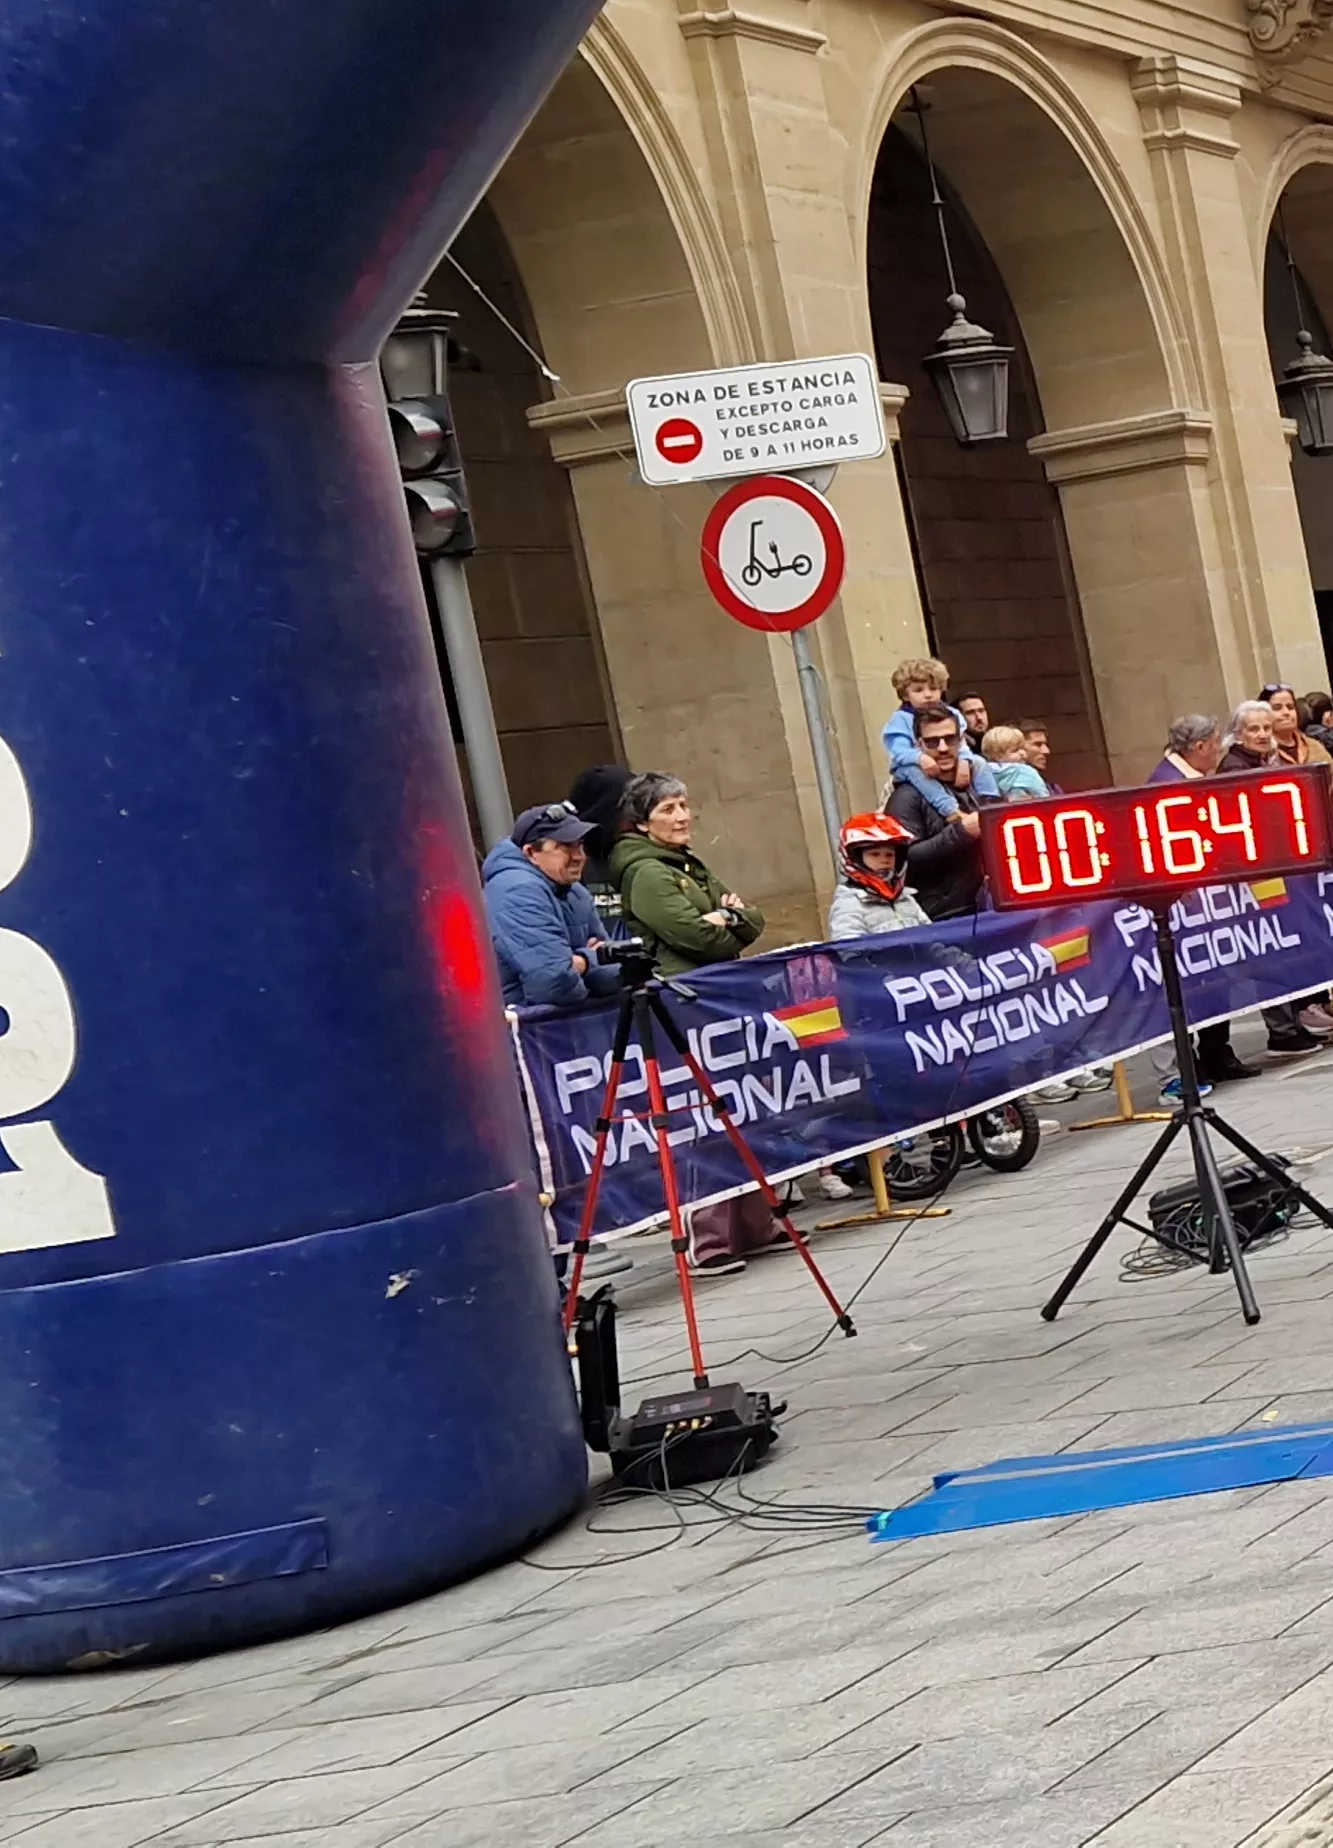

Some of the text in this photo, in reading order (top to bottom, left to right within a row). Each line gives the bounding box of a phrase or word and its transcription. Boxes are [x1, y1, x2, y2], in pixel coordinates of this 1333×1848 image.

[647, 370, 856, 408] ZONA DE ESTANCIA
[715, 392, 858, 420] EXCEPTO CARGA
[719, 416, 828, 440] Y DESCARGA
[723, 433, 859, 462] DE 9 A 11 HORAS
[1003, 782, 1309, 894] 00:16:47
[905, 978, 1109, 1073] NACIONAL
